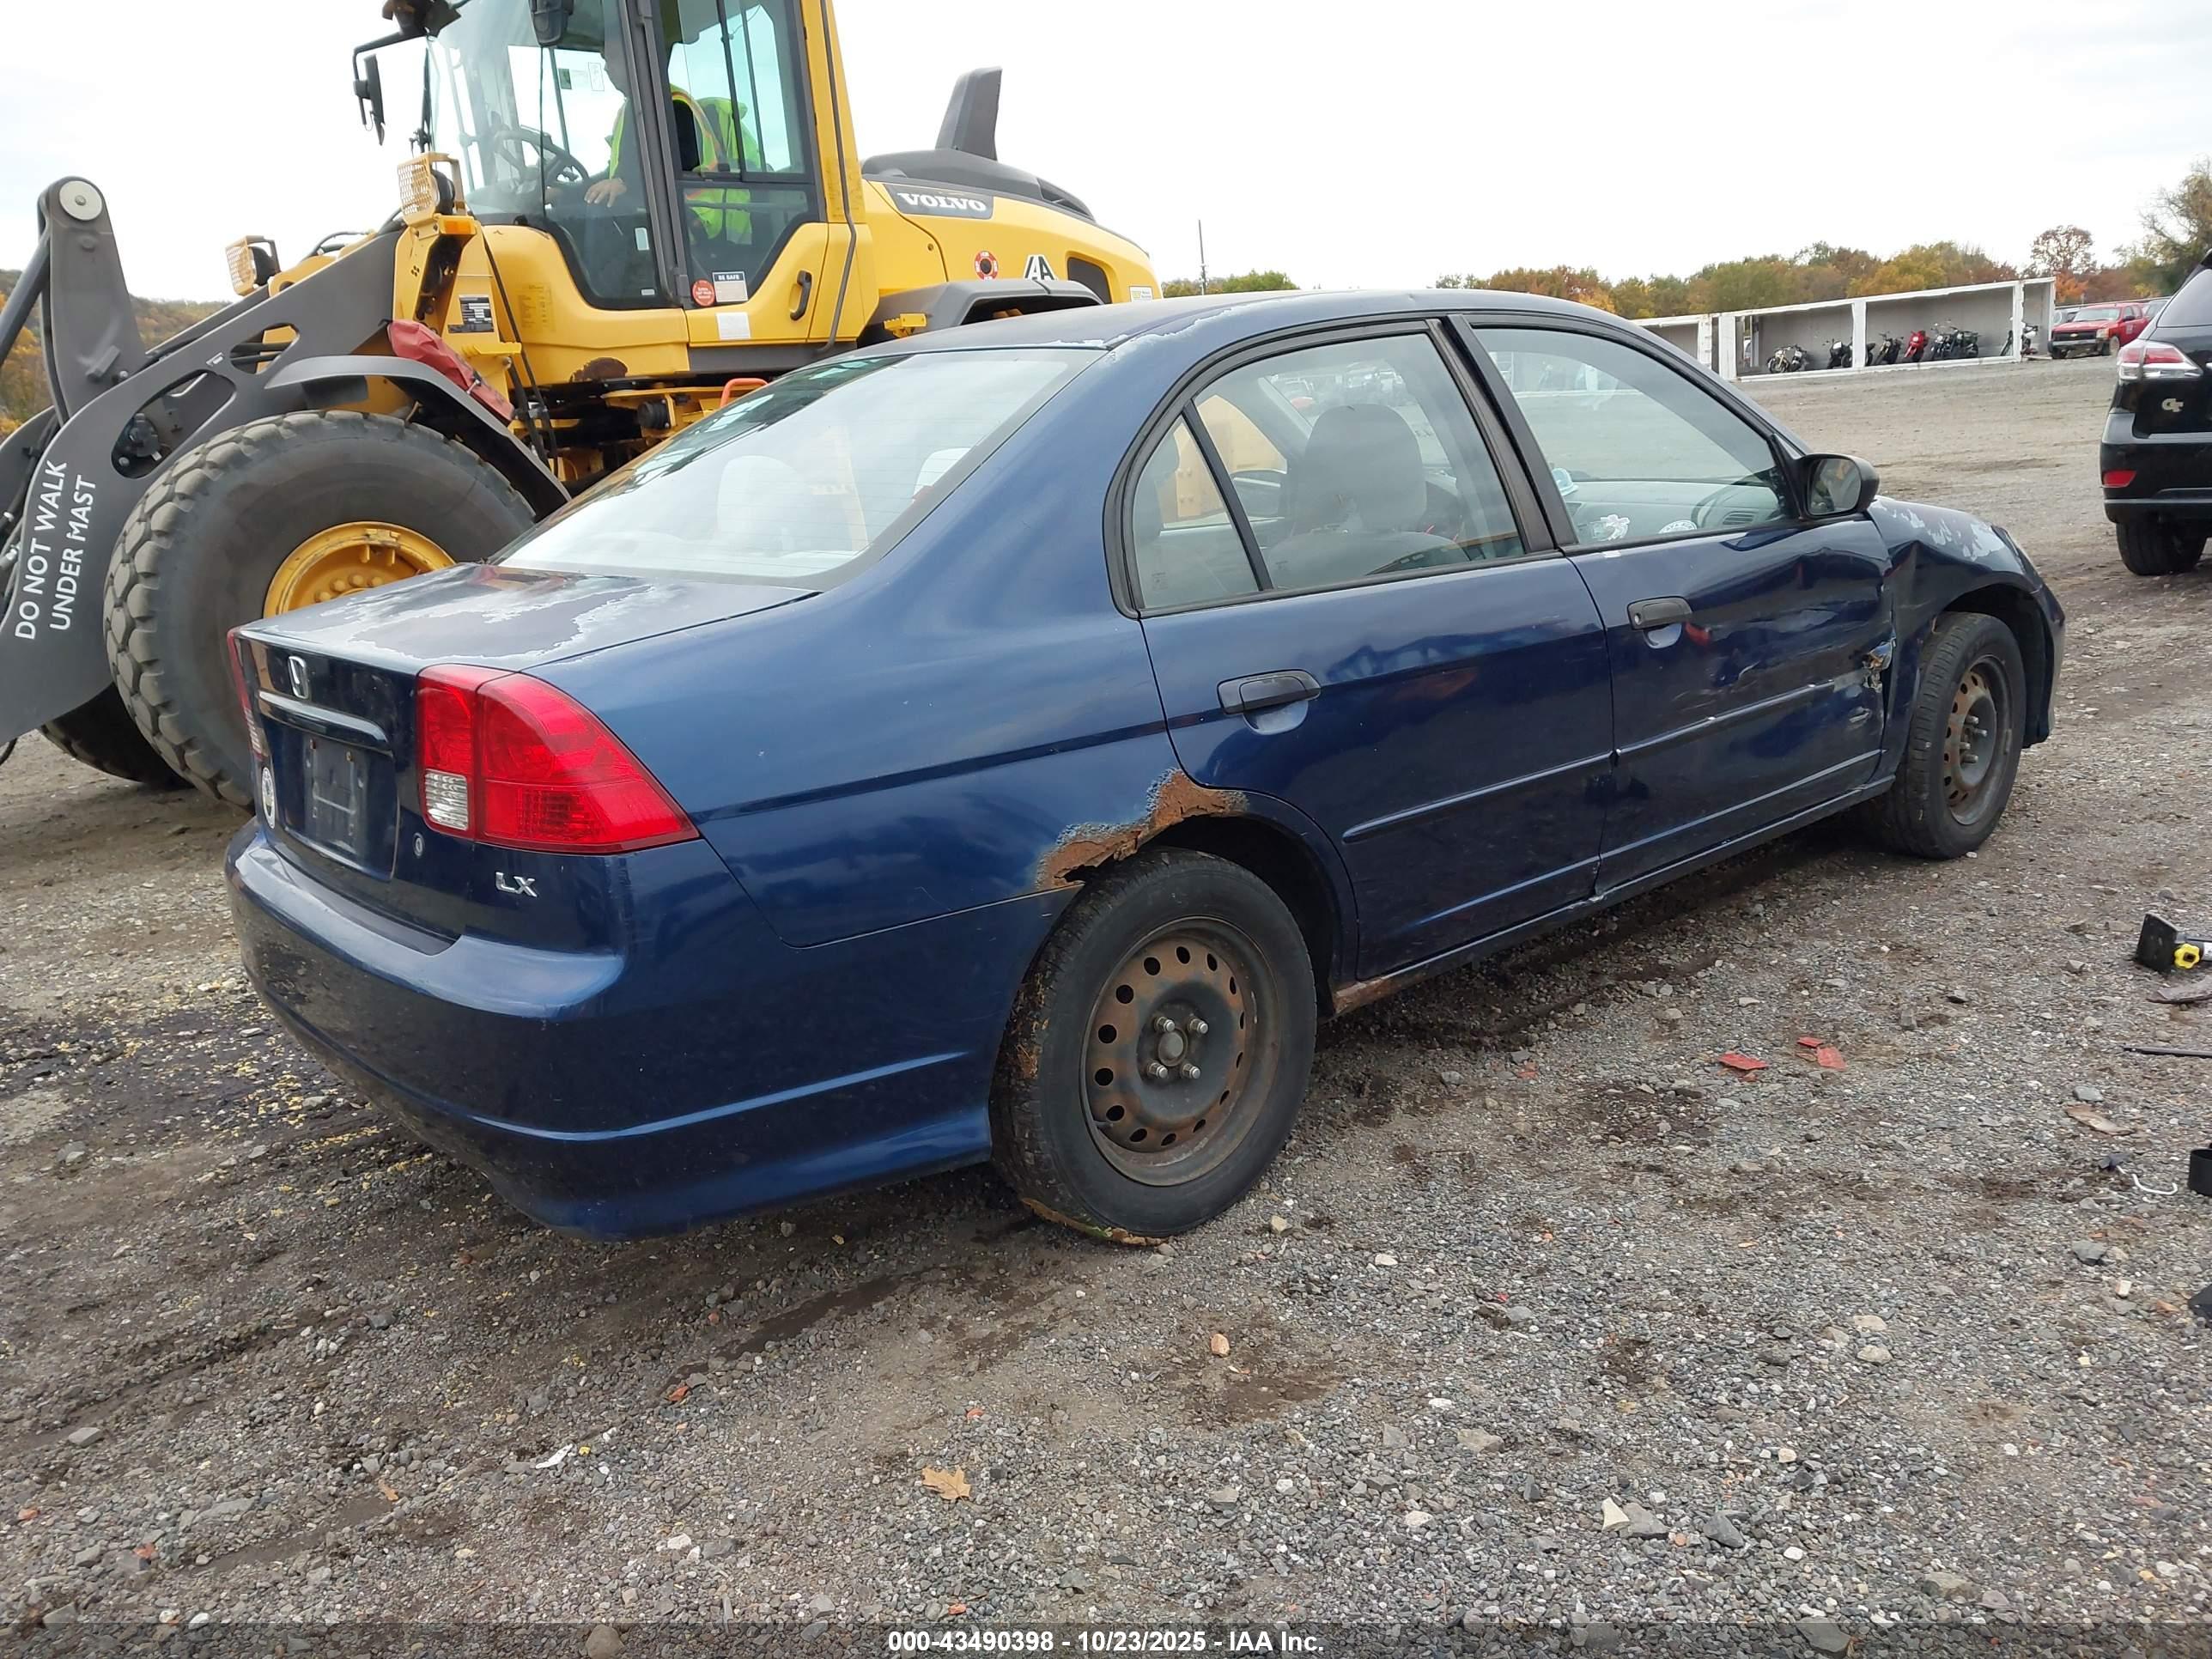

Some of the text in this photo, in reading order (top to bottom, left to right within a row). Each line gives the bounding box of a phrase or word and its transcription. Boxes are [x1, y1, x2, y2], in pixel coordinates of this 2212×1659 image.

[896, 192, 988, 212] VOLVO
[15, 459, 68, 640] DO NOT WALK
[49, 474, 96, 630] UNDER MAST
[495, 872, 538, 897] LX
